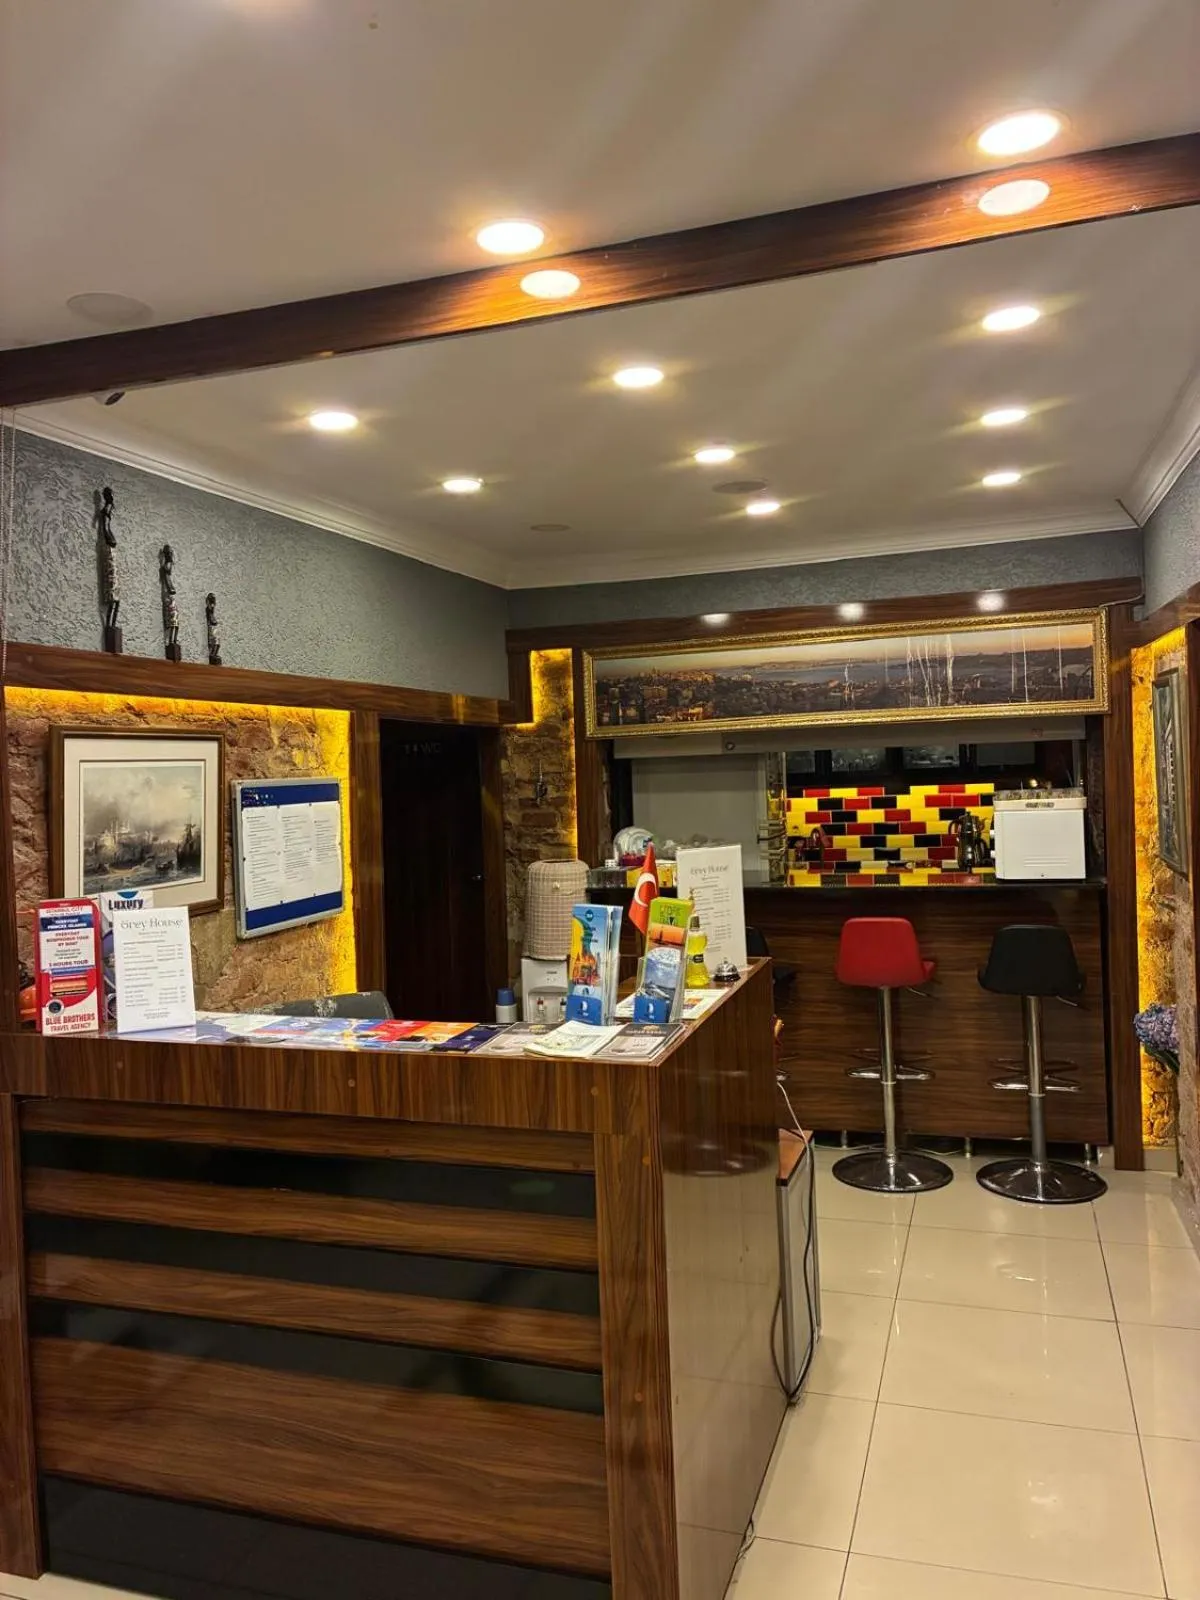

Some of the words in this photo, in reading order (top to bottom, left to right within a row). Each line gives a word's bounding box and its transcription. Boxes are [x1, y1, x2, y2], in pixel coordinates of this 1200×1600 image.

[108, 899, 144, 911] Luxury
[120, 918, 147, 931] Grey
[149, 916, 184, 929] House
[45, 1015, 62, 1026] BLUE
[63, 1012, 96, 1024] BROTHERS
[50, 1024, 70, 1032] TRAVEL
